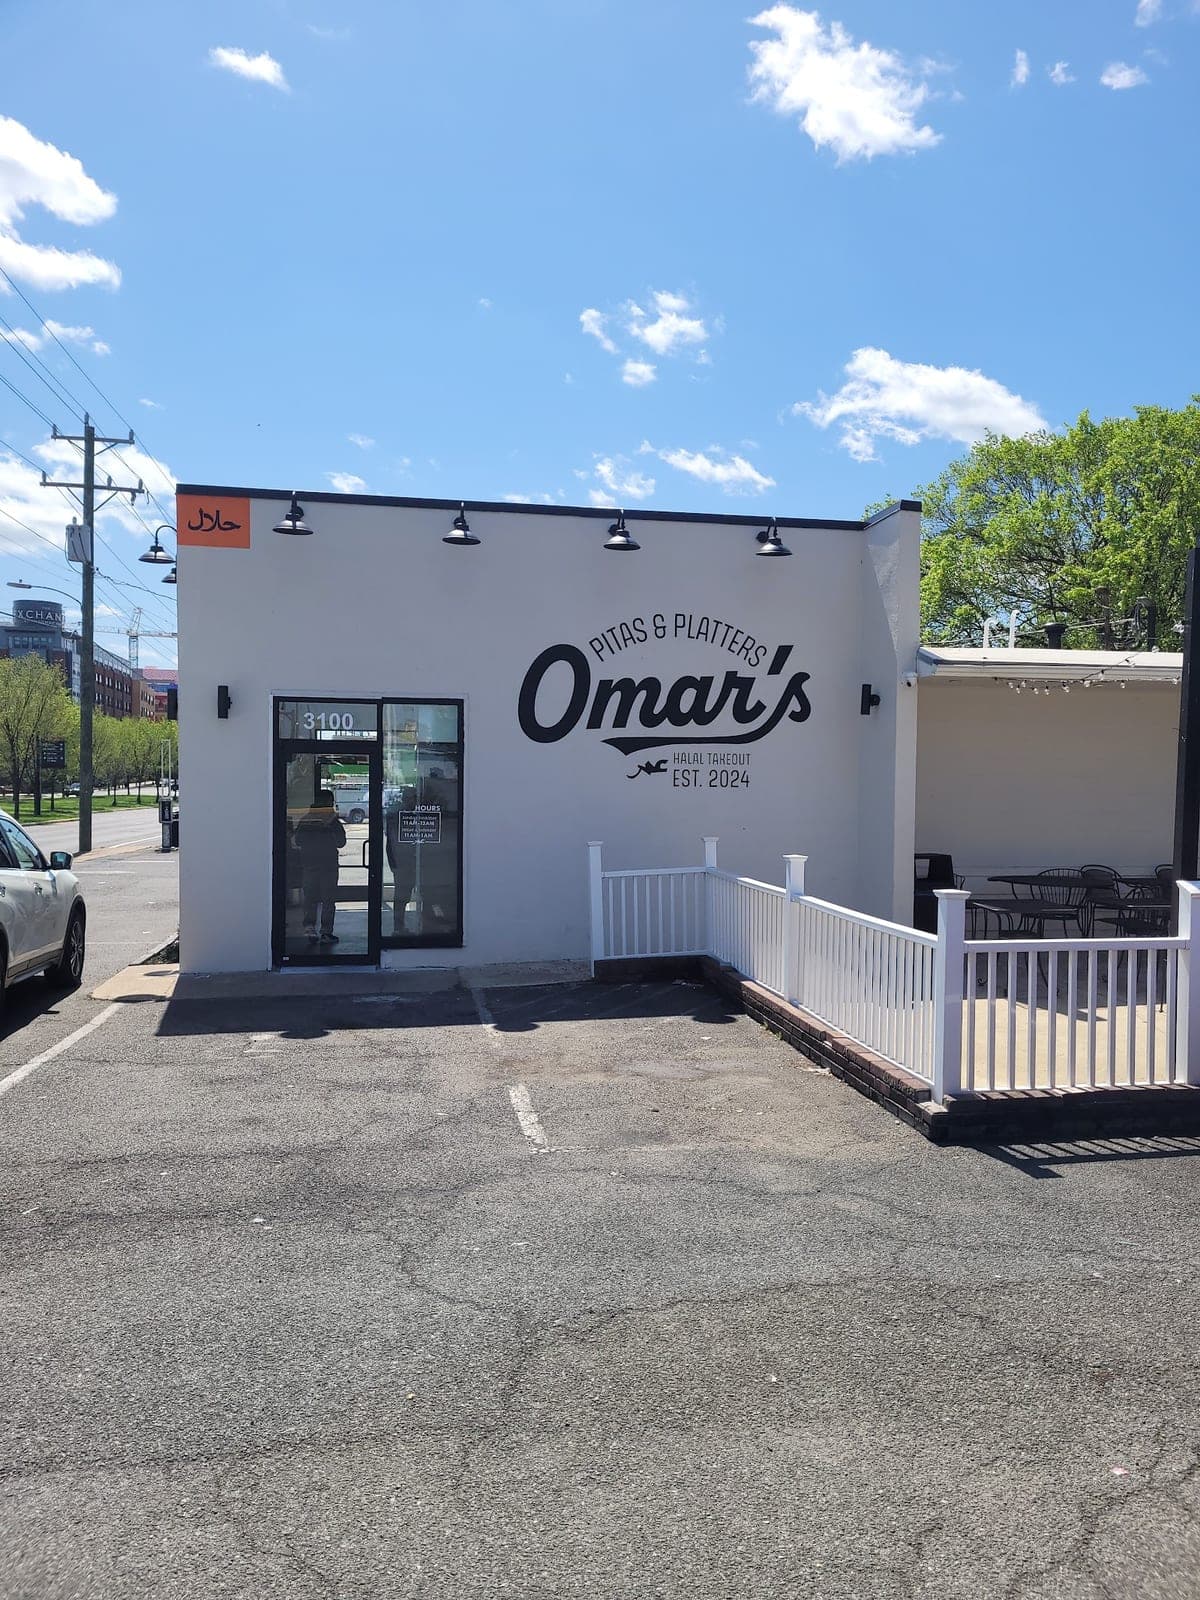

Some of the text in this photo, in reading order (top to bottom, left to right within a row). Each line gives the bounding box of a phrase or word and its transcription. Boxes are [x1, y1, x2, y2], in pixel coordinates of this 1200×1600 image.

[187, 507, 242, 532] حلال
[14, 609, 62, 622] XCHAN
[588, 613, 768, 668] PITAS & PLATTERS
[517, 643, 812, 756] Omar's
[303, 712, 354, 731] 3100
[673, 752, 752, 766] HALAL TAKEOUT
[673, 769, 750, 788] EST. 2024
[415, 804, 441, 812] HOURS
